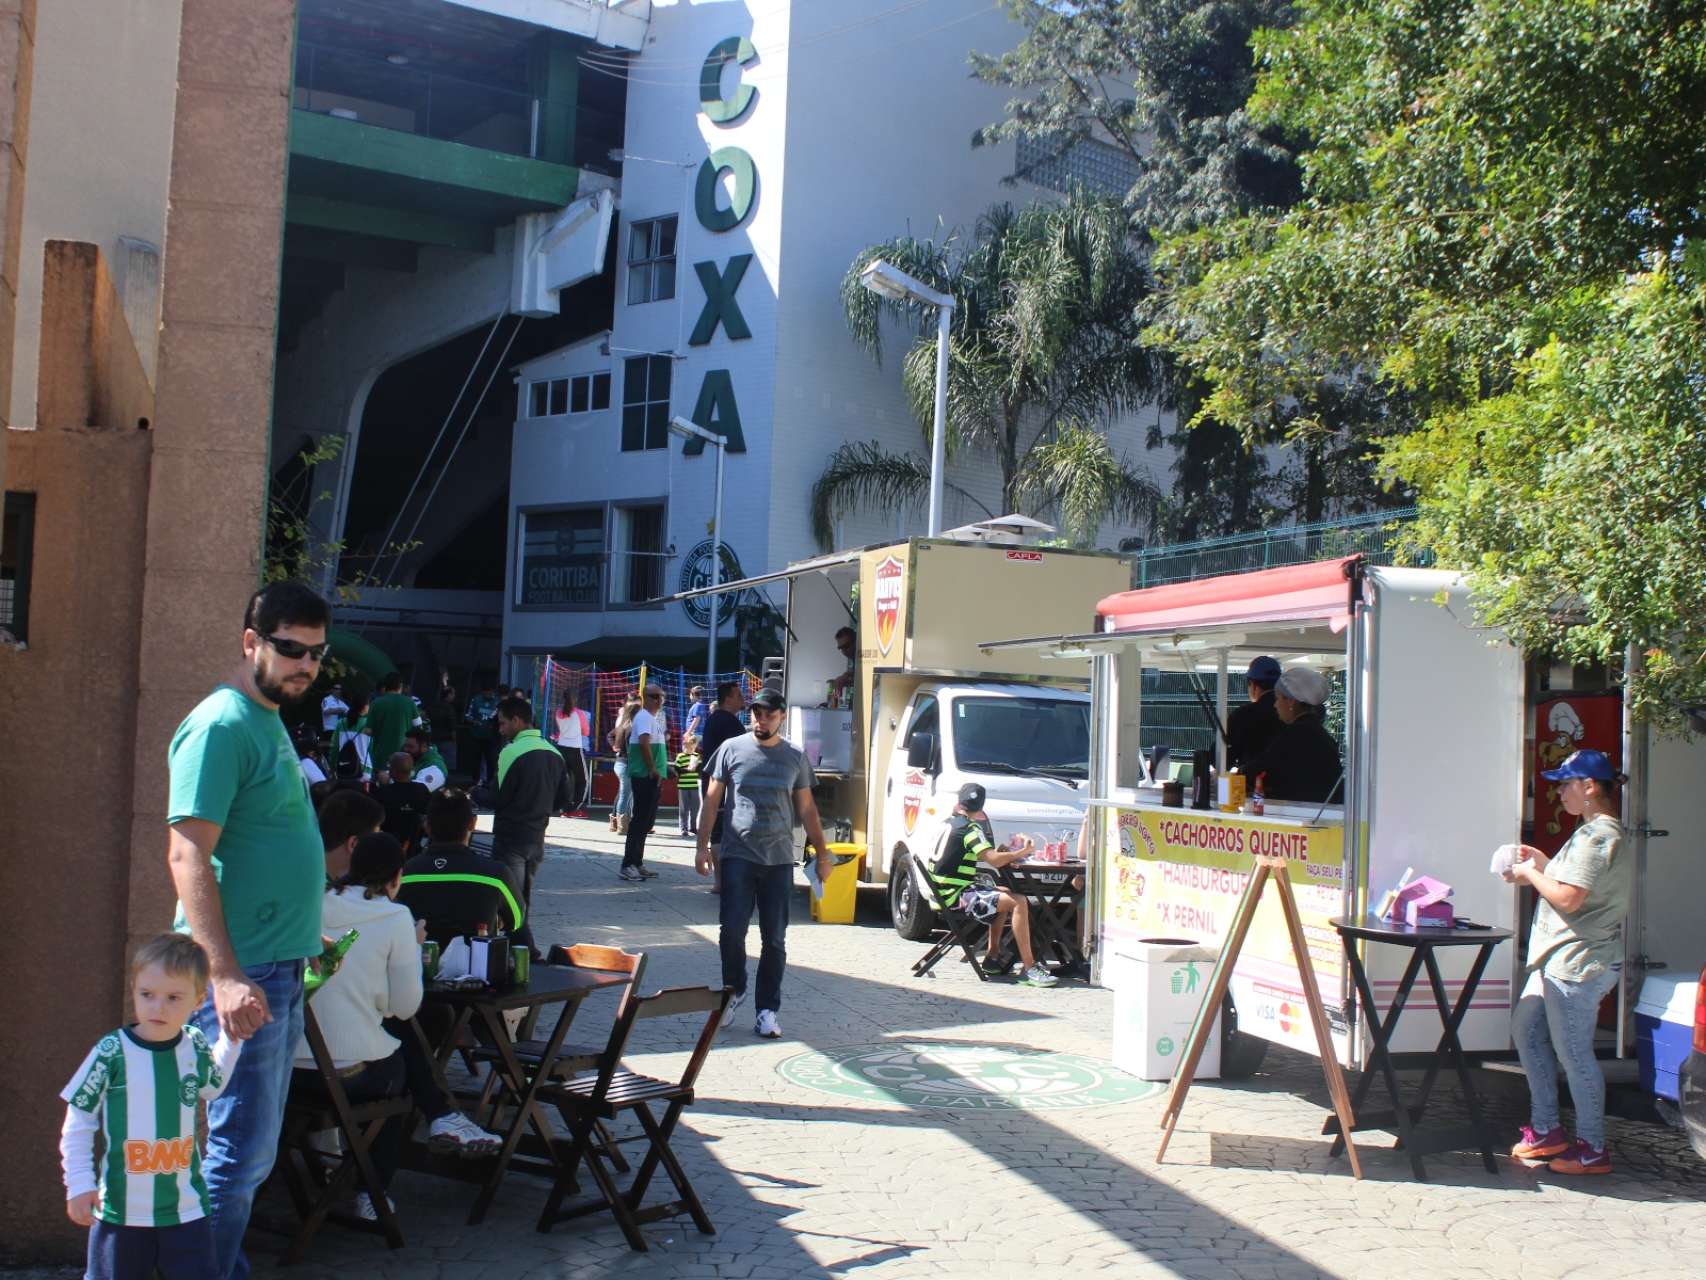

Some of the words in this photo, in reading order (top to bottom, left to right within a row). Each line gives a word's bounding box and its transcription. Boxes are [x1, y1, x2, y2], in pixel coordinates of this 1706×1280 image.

[682, 35, 760, 456] COXA
[529, 566, 599, 589] CORITIBA
[1250, 829, 1308, 861] QUENTE
[1322, 865, 1334, 877] SEU
[1174, 904, 1217, 934] PERNIL
[1256, 1001, 1275, 1021] VISA
